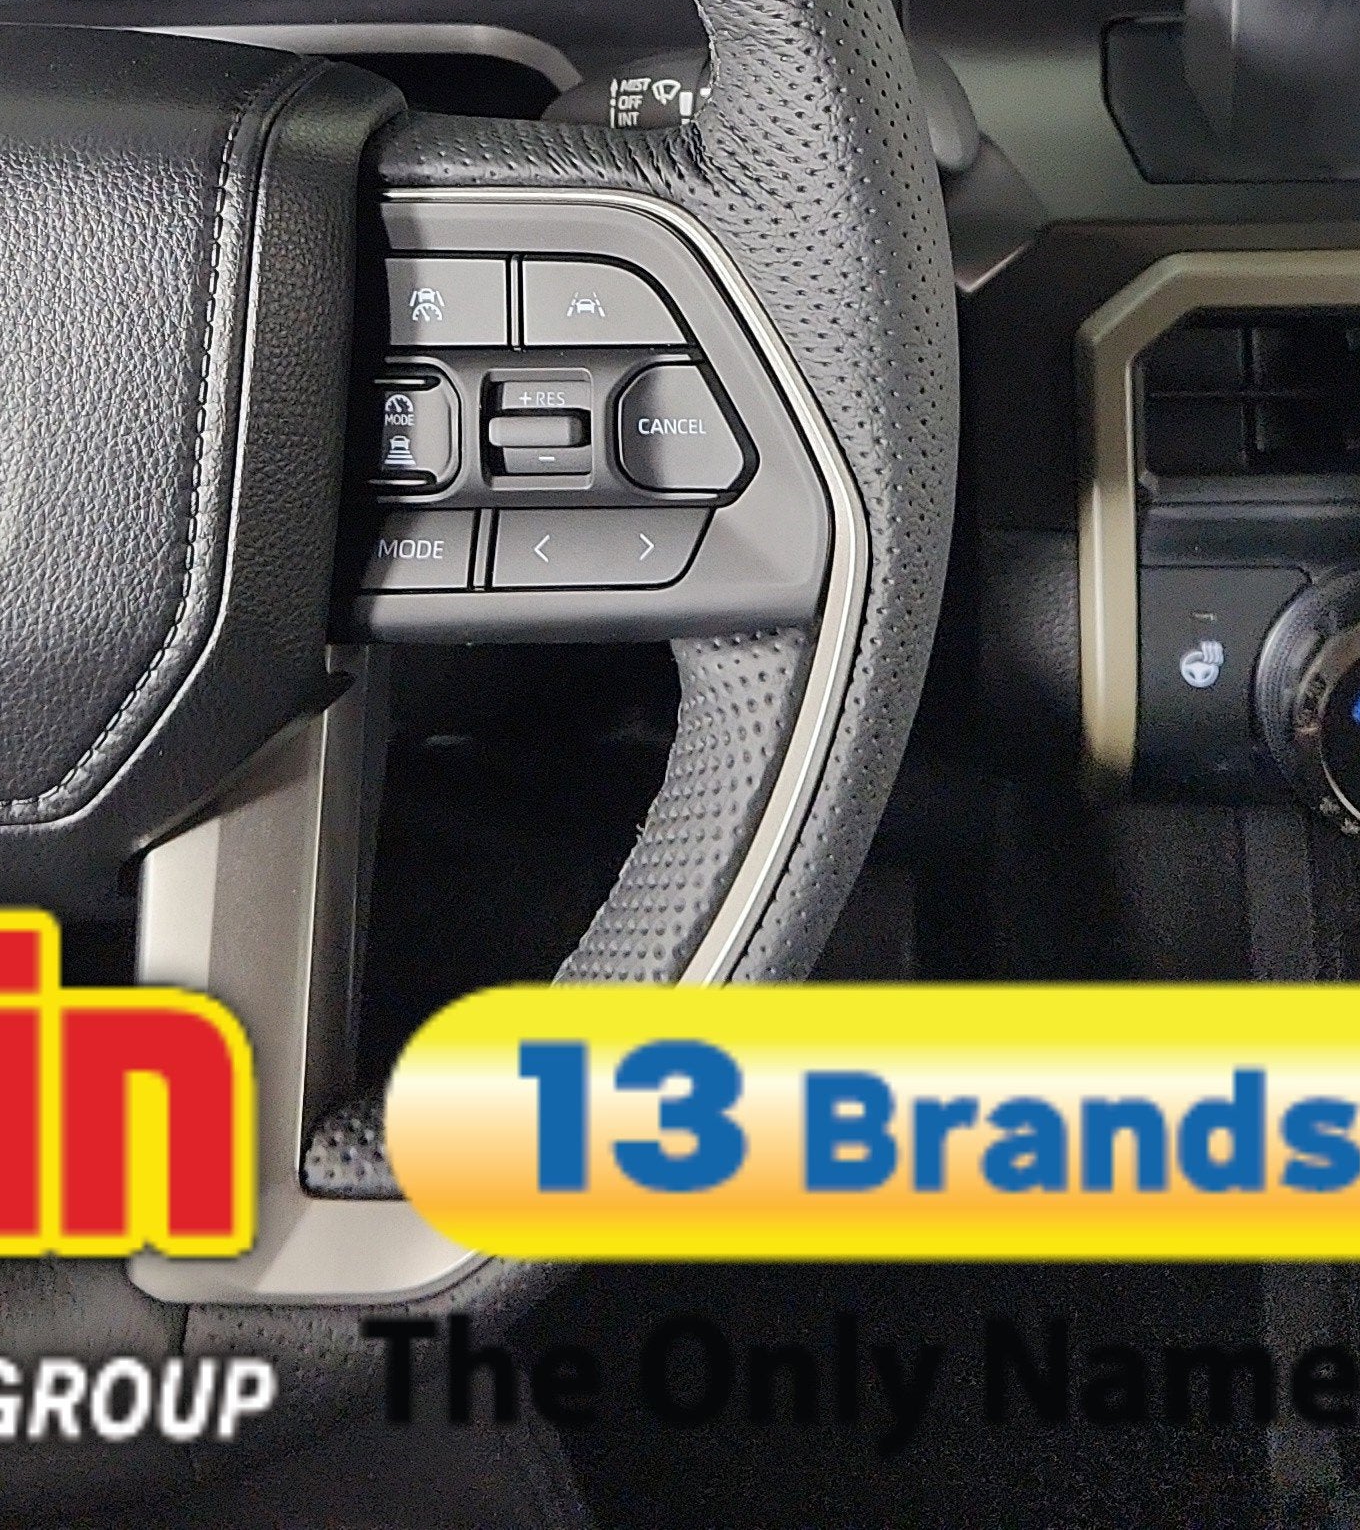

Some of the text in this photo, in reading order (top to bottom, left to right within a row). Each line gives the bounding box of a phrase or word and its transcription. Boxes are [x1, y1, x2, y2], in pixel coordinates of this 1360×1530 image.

[620, 78, 652, 92] MIST
[618, 95, 643, 110] OFF
[617, 111, 640, 127] INT
[536, 392, 565, 406] RES
[384, 414, 415, 426] MODE
[638, 417, 707, 437] CANCEL
[377, 539, 444, 559] MODE
